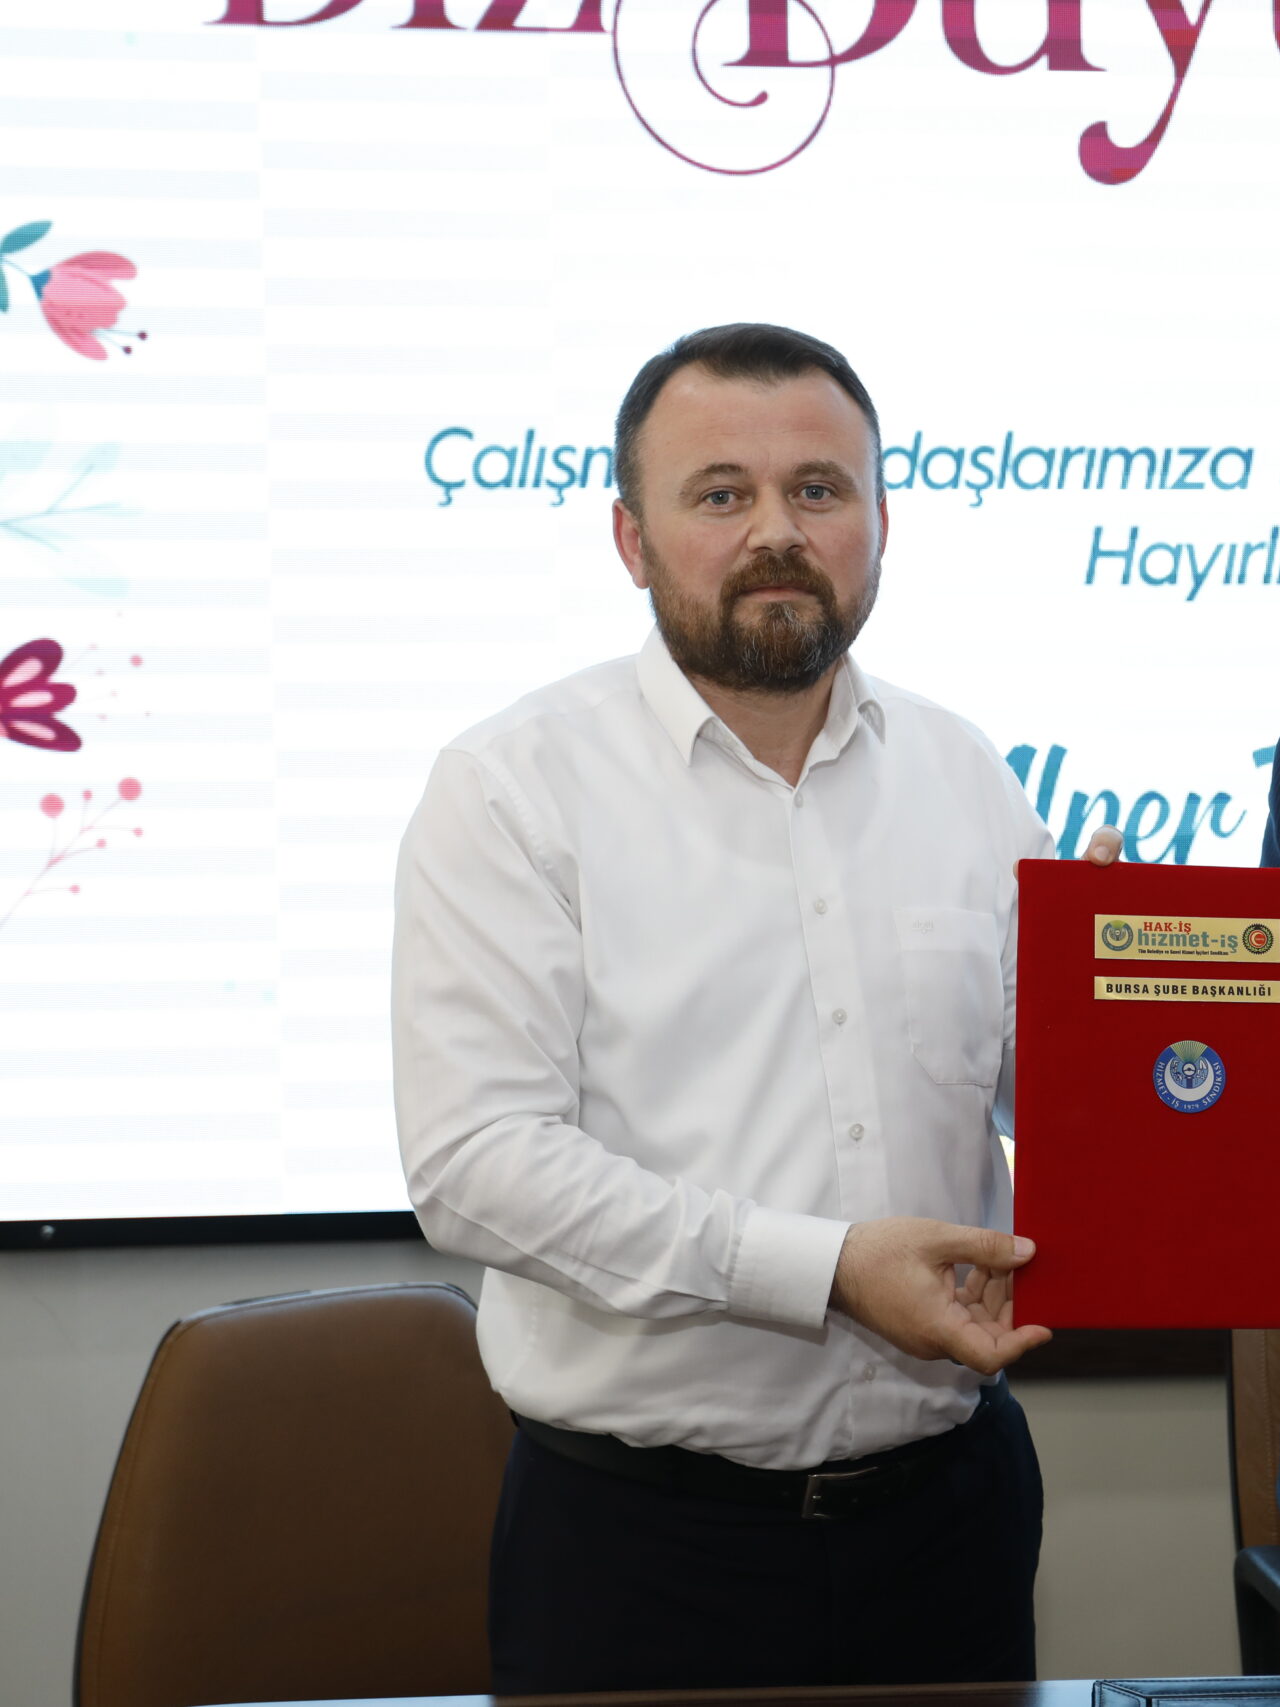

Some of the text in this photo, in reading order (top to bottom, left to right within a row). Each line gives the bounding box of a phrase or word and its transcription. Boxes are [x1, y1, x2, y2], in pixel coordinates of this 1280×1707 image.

[424, 426, 614, 508] Çalışm
[881, 429, 1254, 508] daşlarımıza
[1143, 921, 1192, 935] HAK-İŞ
[1137, 928, 1239, 954] hizmet-iş
[1106, 983, 1272, 998] BURSA ŞUBE BAŞKANLIĞI
